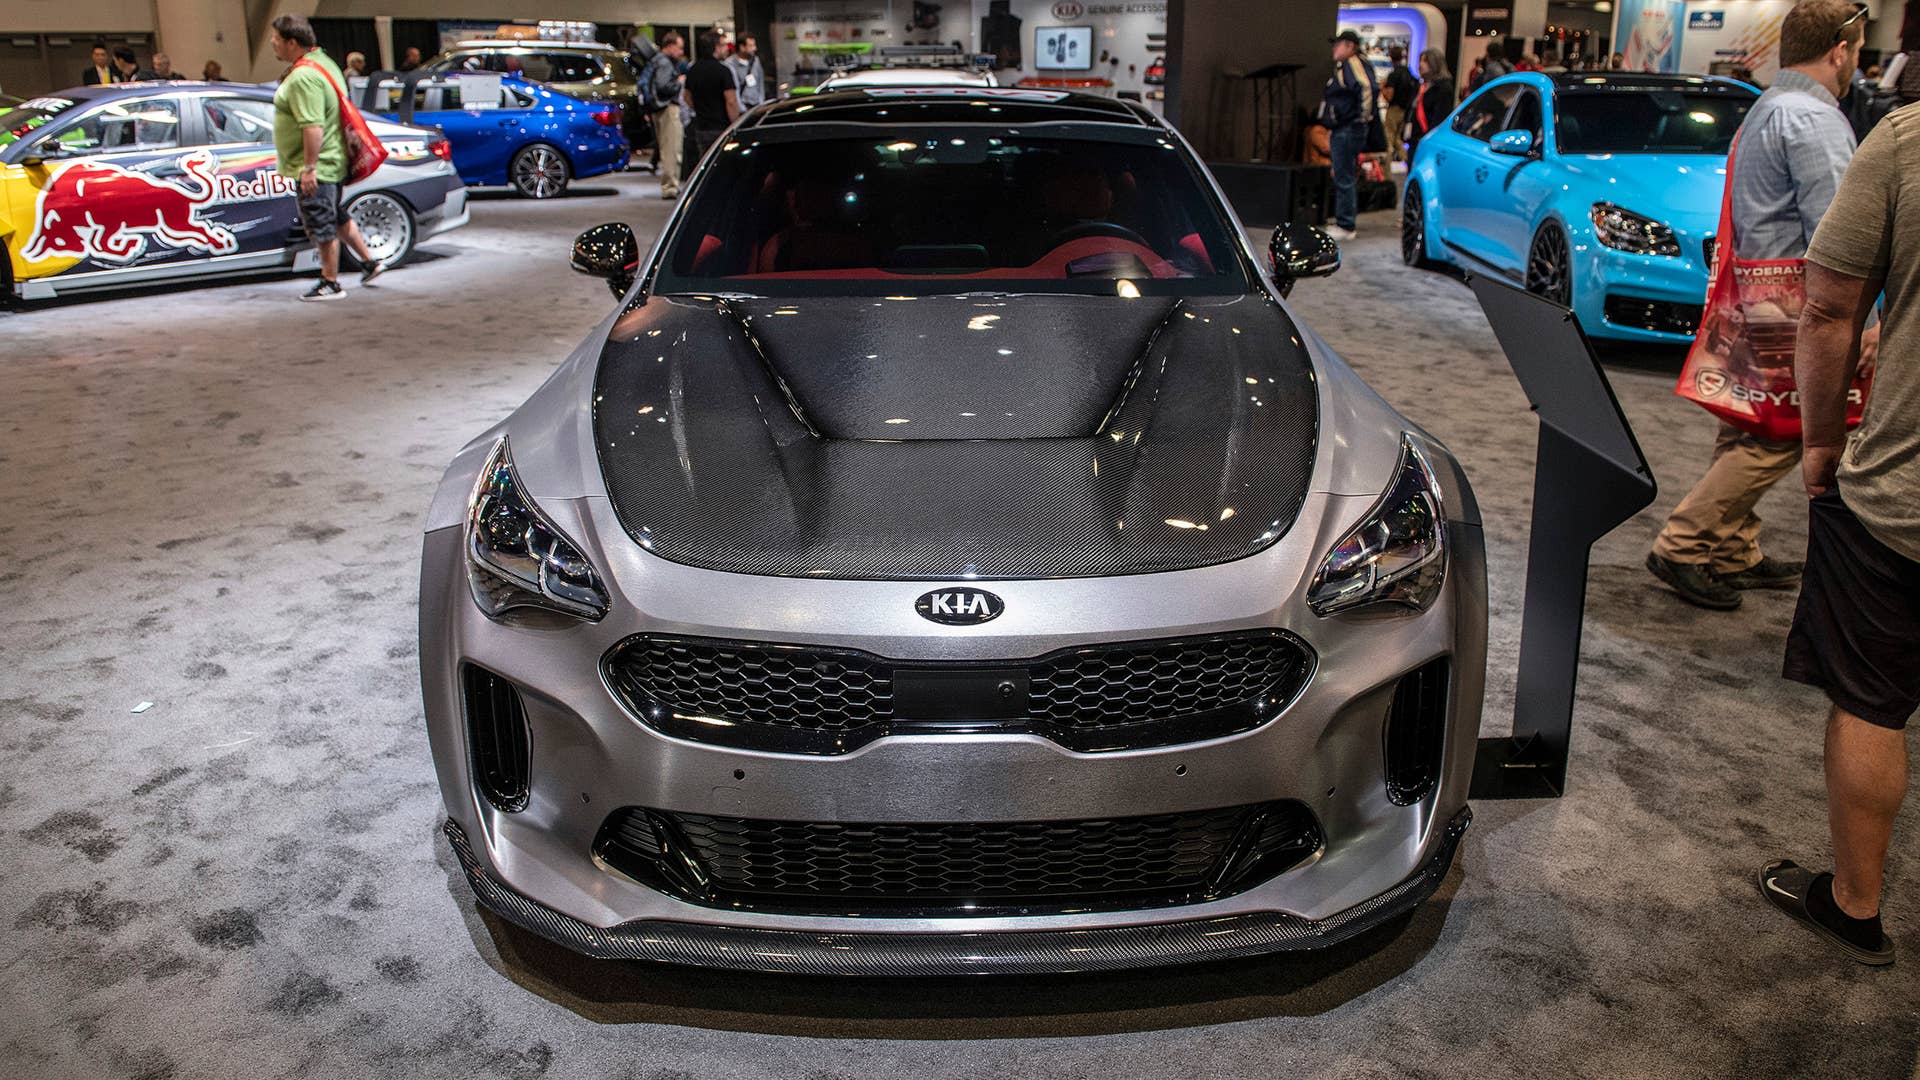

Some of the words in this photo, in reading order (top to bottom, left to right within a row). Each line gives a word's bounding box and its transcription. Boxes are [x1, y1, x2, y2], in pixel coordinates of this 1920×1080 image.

[219, 172, 267, 199] Red
[270, 173, 297, 195] Bu
[1731, 383, 1863, 406] SPYDR
[930, 593, 991, 615] KIA
